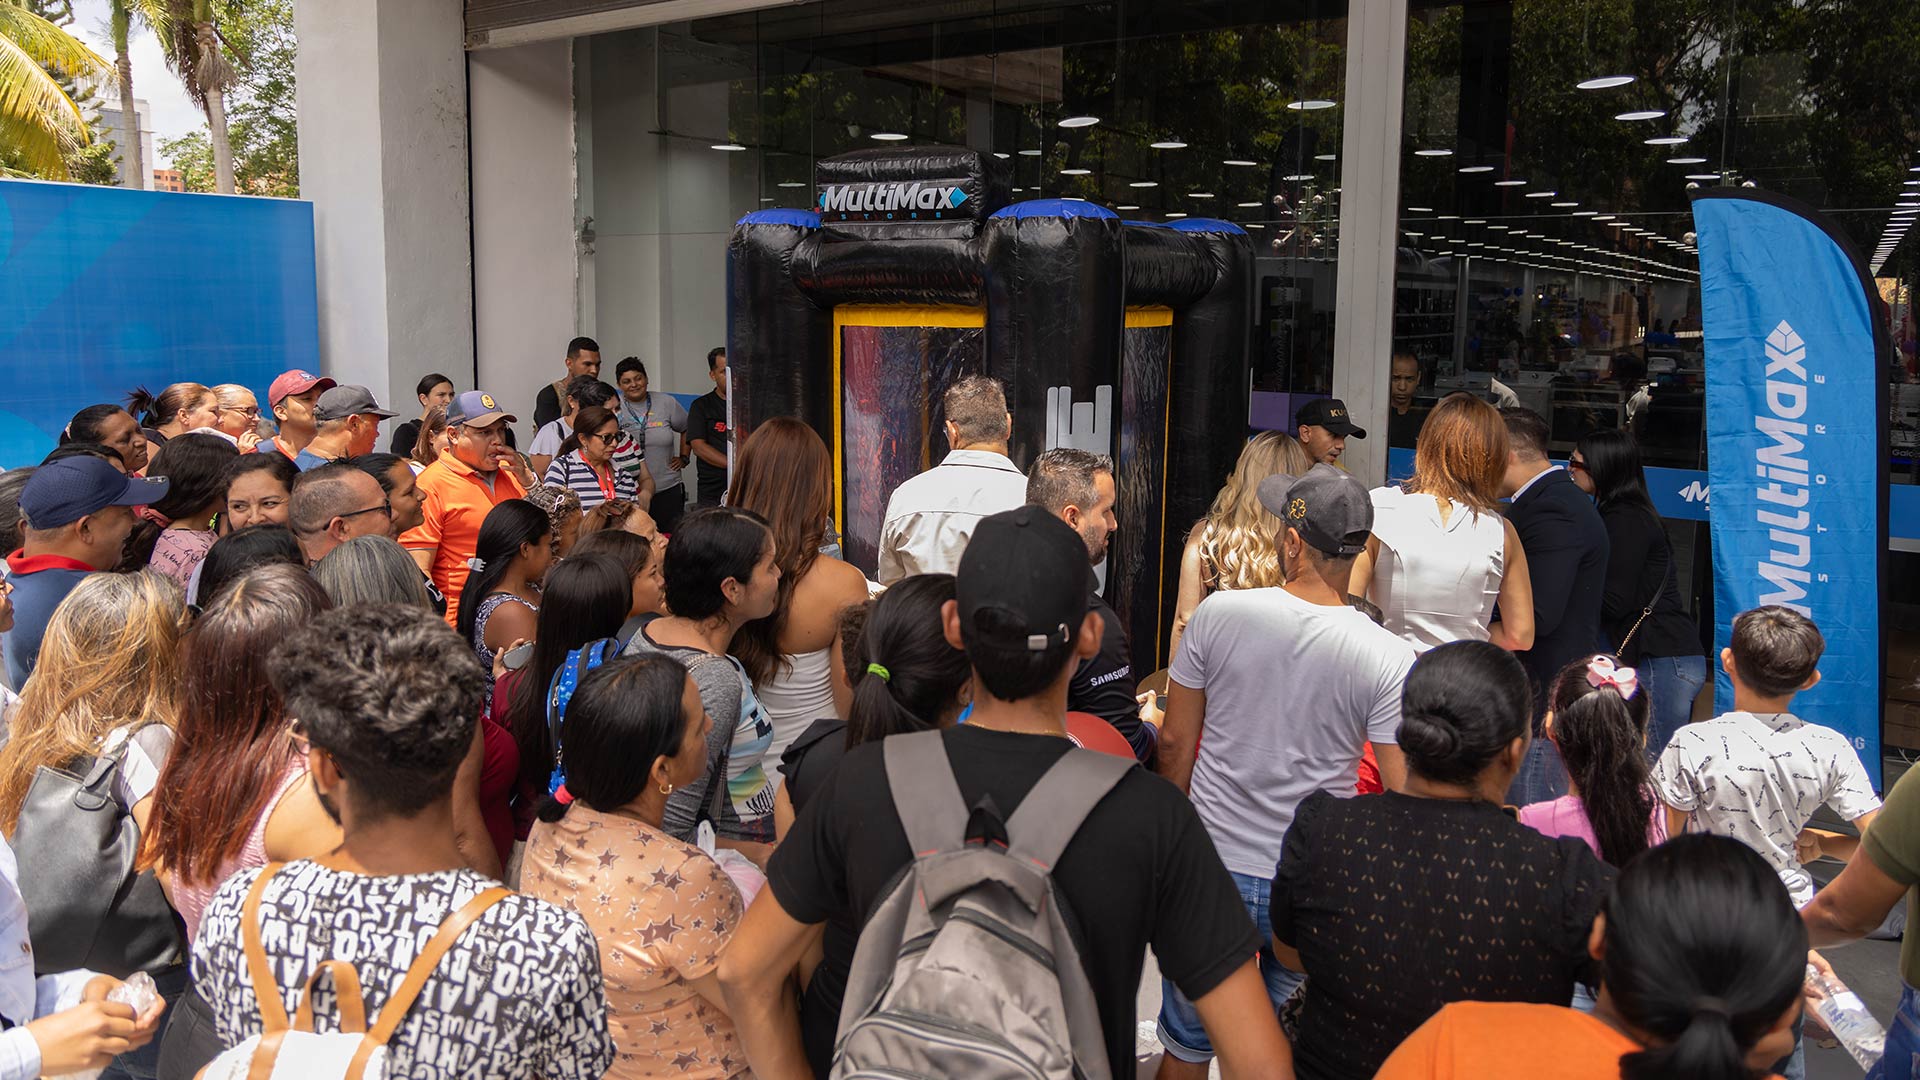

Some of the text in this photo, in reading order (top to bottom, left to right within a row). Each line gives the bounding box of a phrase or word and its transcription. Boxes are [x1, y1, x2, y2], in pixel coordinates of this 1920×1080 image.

[824, 183, 955, 212] MultiMax
[1754, 344, 1812, 619] MultiMax
[1090, 665, 1129, 687] SAMSUNG
